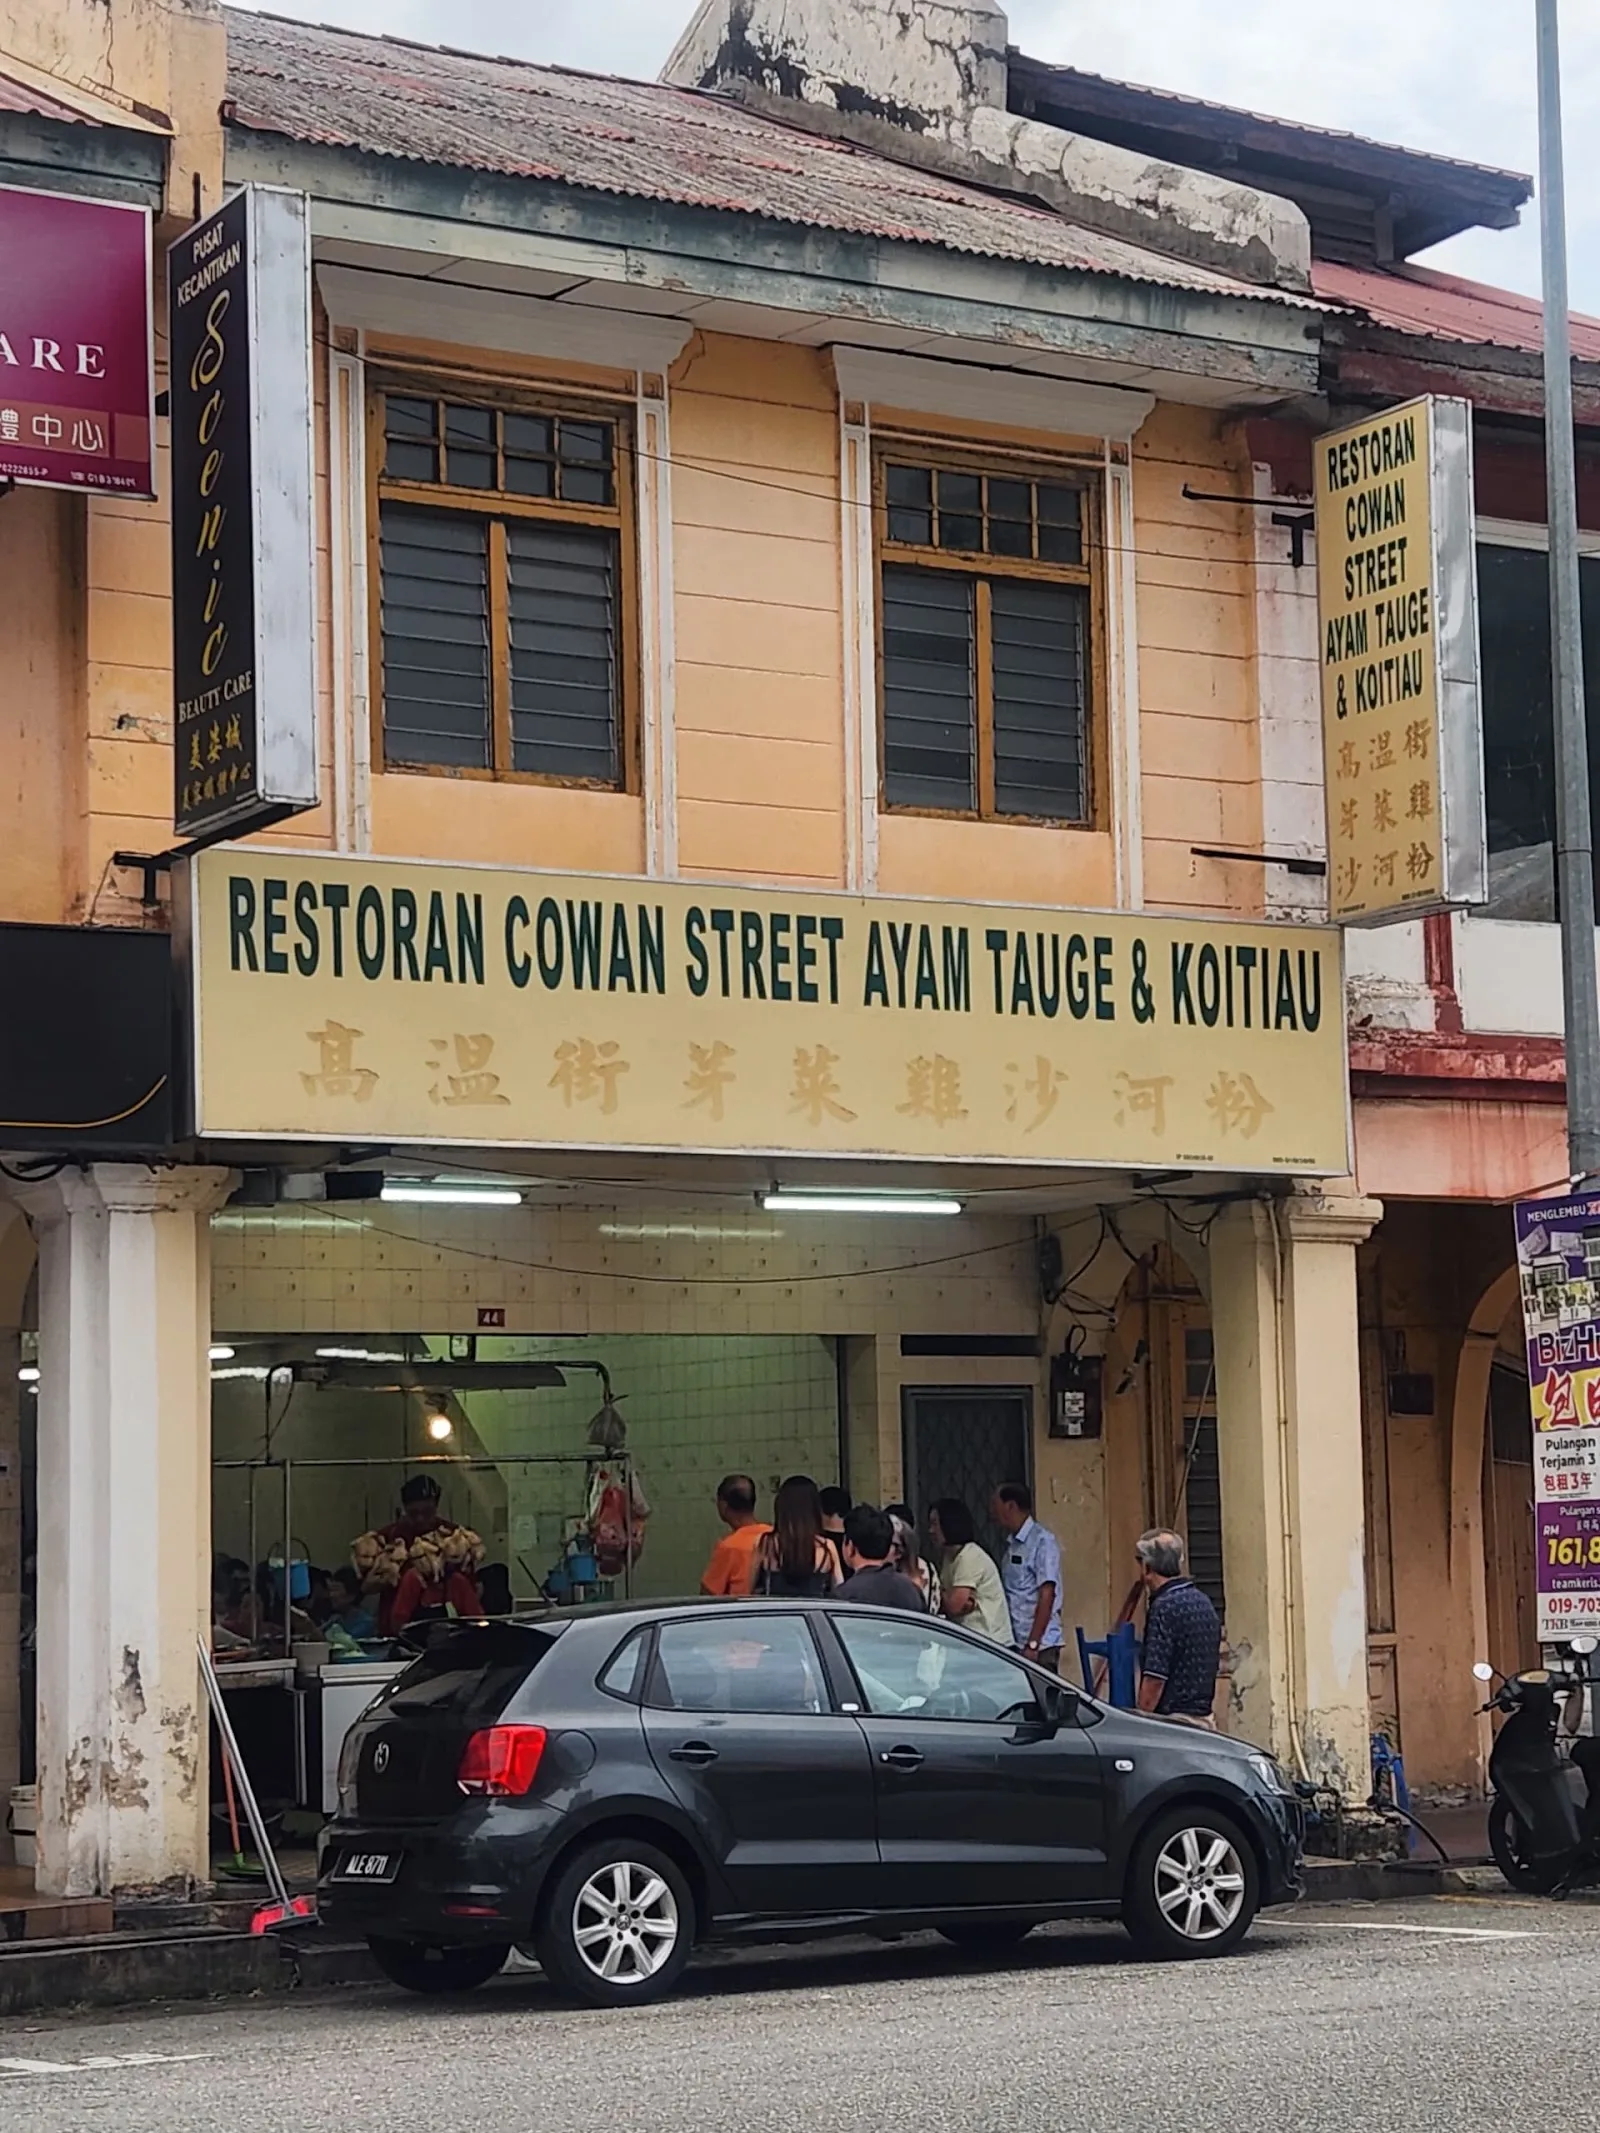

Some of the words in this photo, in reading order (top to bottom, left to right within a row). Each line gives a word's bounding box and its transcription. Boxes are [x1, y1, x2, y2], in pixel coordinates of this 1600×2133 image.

[193, 220, 225, 264] PUSAT
[177, 240, 242, 307] KECANTIKAN
[1327, 416, 1416, 492] RESTORAN
[1345, 477, 1407, 543] COWAN
[1344, 536, 1408, 602] STREET
[1326, 608, 1369, 666] AYAM
[1375, 587, 1429, 649] TAUGE
[179, 686, 222, 724] BEAUTY
[223, 670, 253, 701] CARE
[1336, 673, 1348, 720] &
[1356, 648, 1422, 714] KOITIAU
[1336, 841, 1435, 902] 沙河粉
[229, 876, 485, 985] RESTORAN
[504, 895, 674, 995] COWAN
[685, 906, 844, 1005] STREET
[863, 920, 971, 1013] AYAM
[985, 929, 1116, 1021] TAUGE
[1131, 938, 1156, 1024] &
[1171, 942, 1321, 1033] KOITIAU
[1526, 1204, 1587, 1224] MENGLEMBU
[482, 1311, 499, 1325] 44
[1538, 1324, 1600, 1367] BizH
[1540, 1453, 1585, 1471] Terjamin
[1588, 1452, 1596, 1465] 3
[1545, 1437, 1596, 1451] Pulangan
[1543, 1524, 1560, 1537] RM
[345, 1856, 368, 1875] ALE
